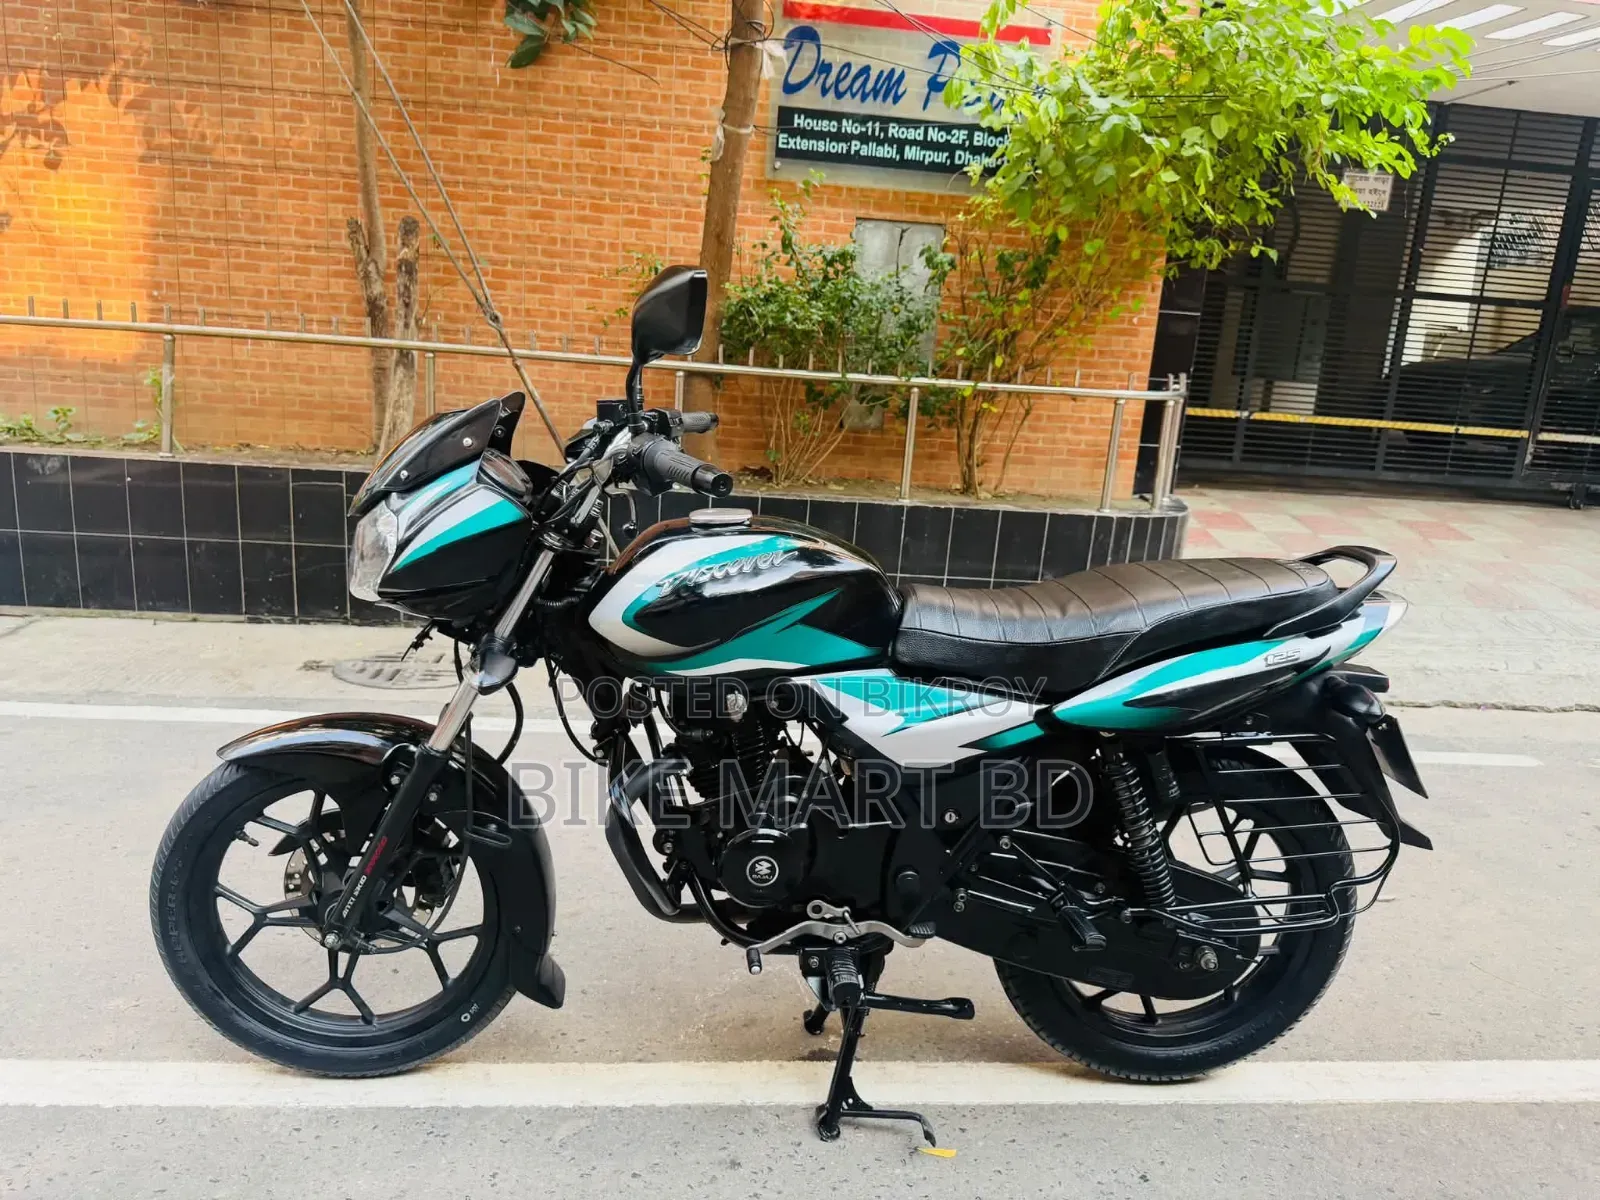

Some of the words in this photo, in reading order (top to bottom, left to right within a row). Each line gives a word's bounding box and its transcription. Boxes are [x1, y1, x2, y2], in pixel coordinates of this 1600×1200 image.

[782, 25, 907, 106] Dream
[793, 113, 838, 133] House
[841, 118, 883, 139] No-11,
[888, 125, 923, 142] Road
[927, 127, 969, 148] No-2F,
[778, 133, 847, 154] Extension
[850, 141, 900, 161] Pallabi,
[904, 148, 951, 168] Mirpur,
[655, 550, 799, 598] Discover
[1264, 649, 1301, 667] 125
